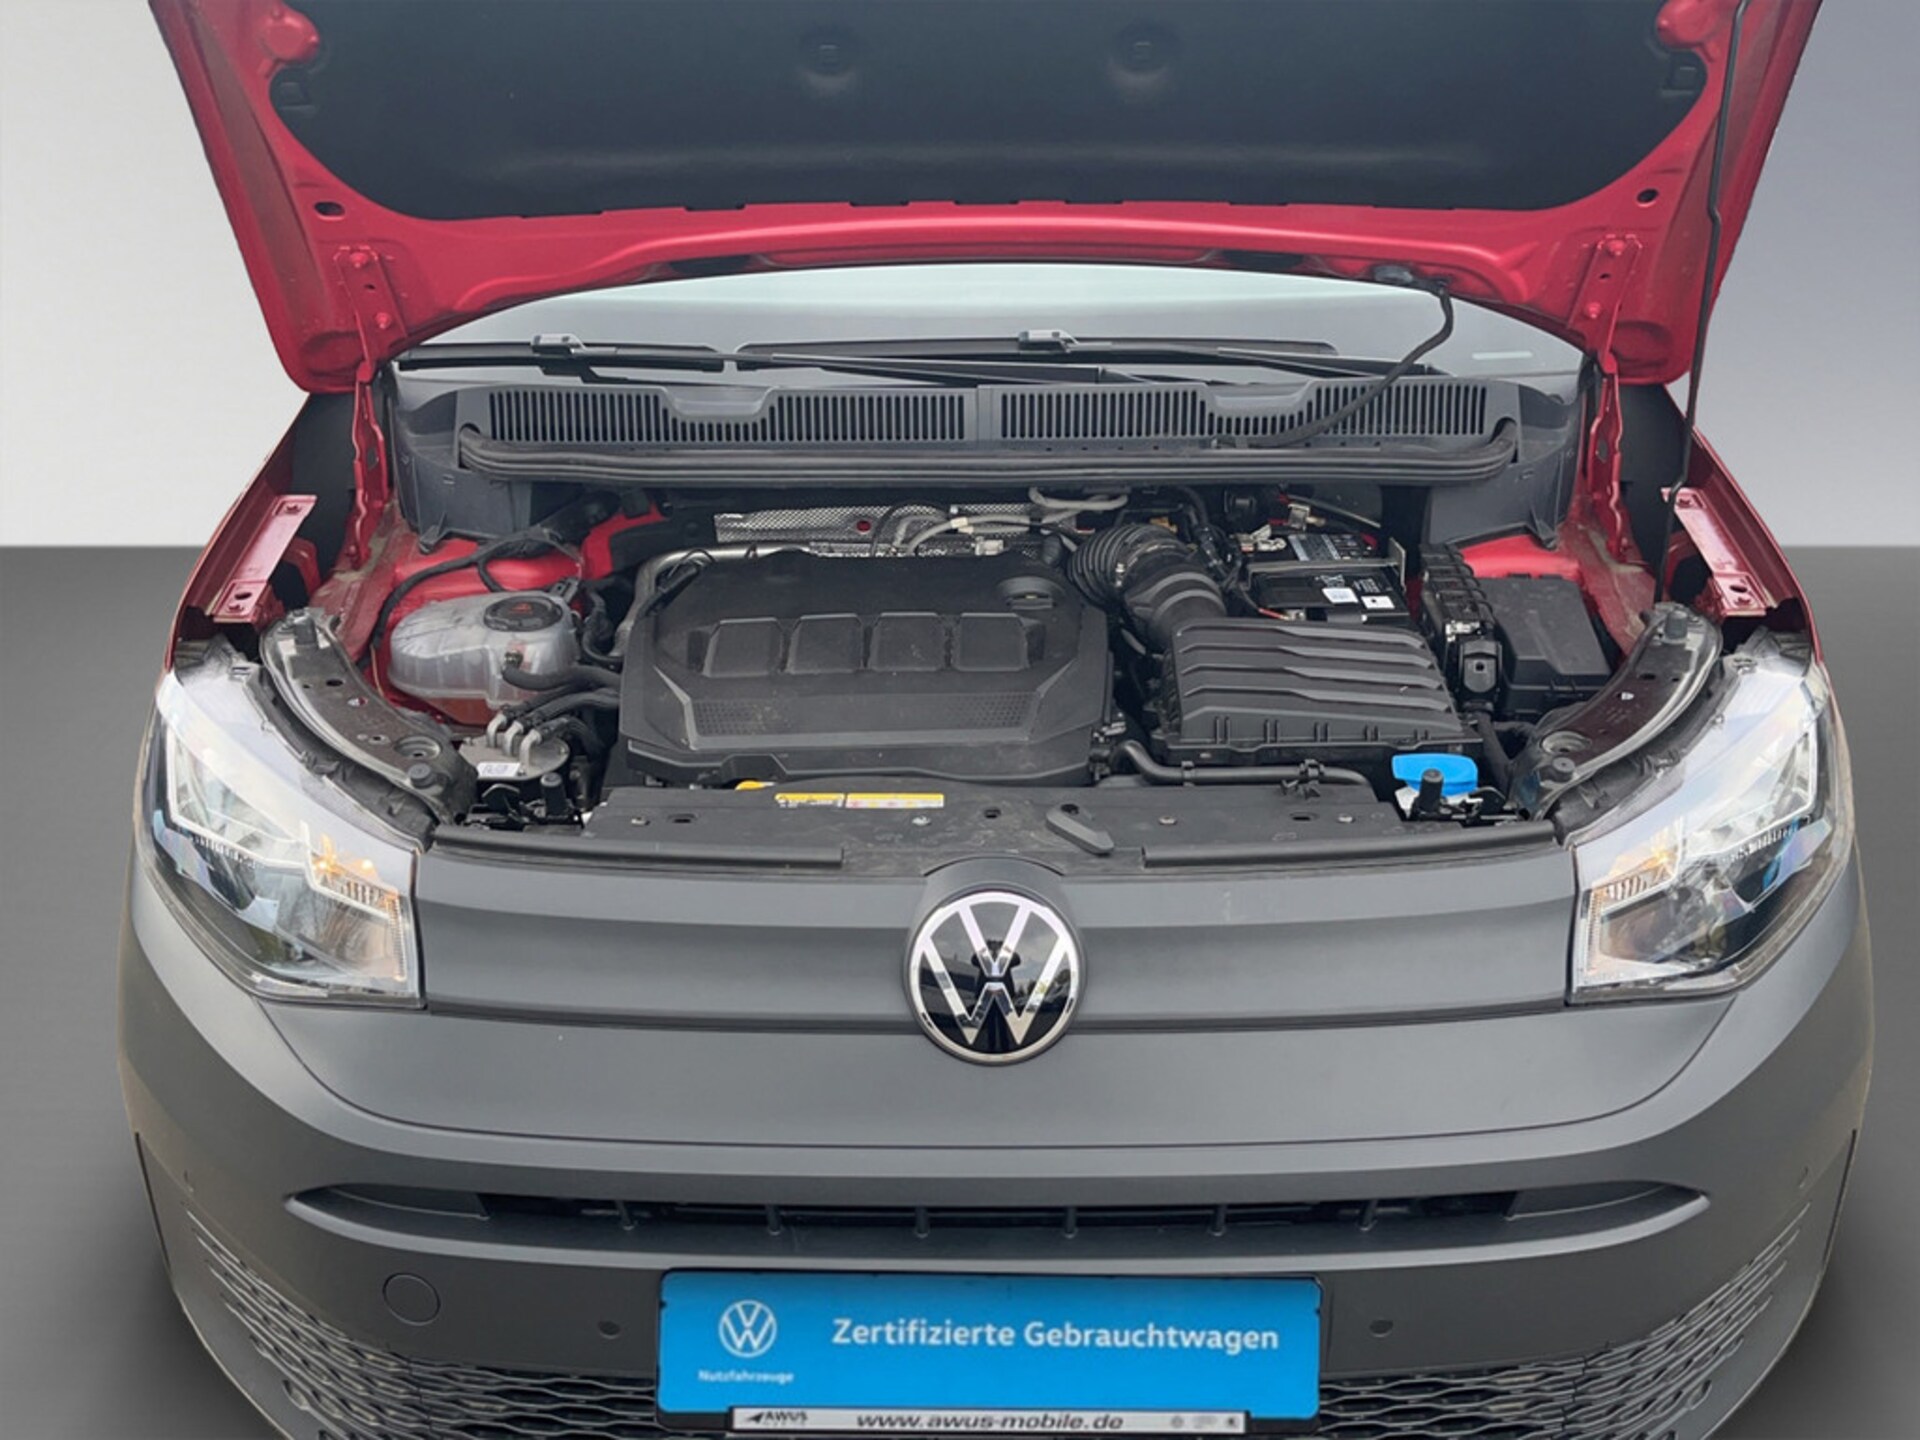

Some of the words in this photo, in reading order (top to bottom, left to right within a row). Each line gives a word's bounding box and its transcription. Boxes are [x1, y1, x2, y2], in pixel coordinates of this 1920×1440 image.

[832, 1318, 1015, 1346] Zertifizierte
[1024, 1321, 1279, 1355] Gebrauchtwagen
[698, 1369, 795, 1385] Nutzfahrzeuge
[764, 1411, 808, 1422] AWUS
[856, 1413, 1124, 1430] www.awus-mobile.de
